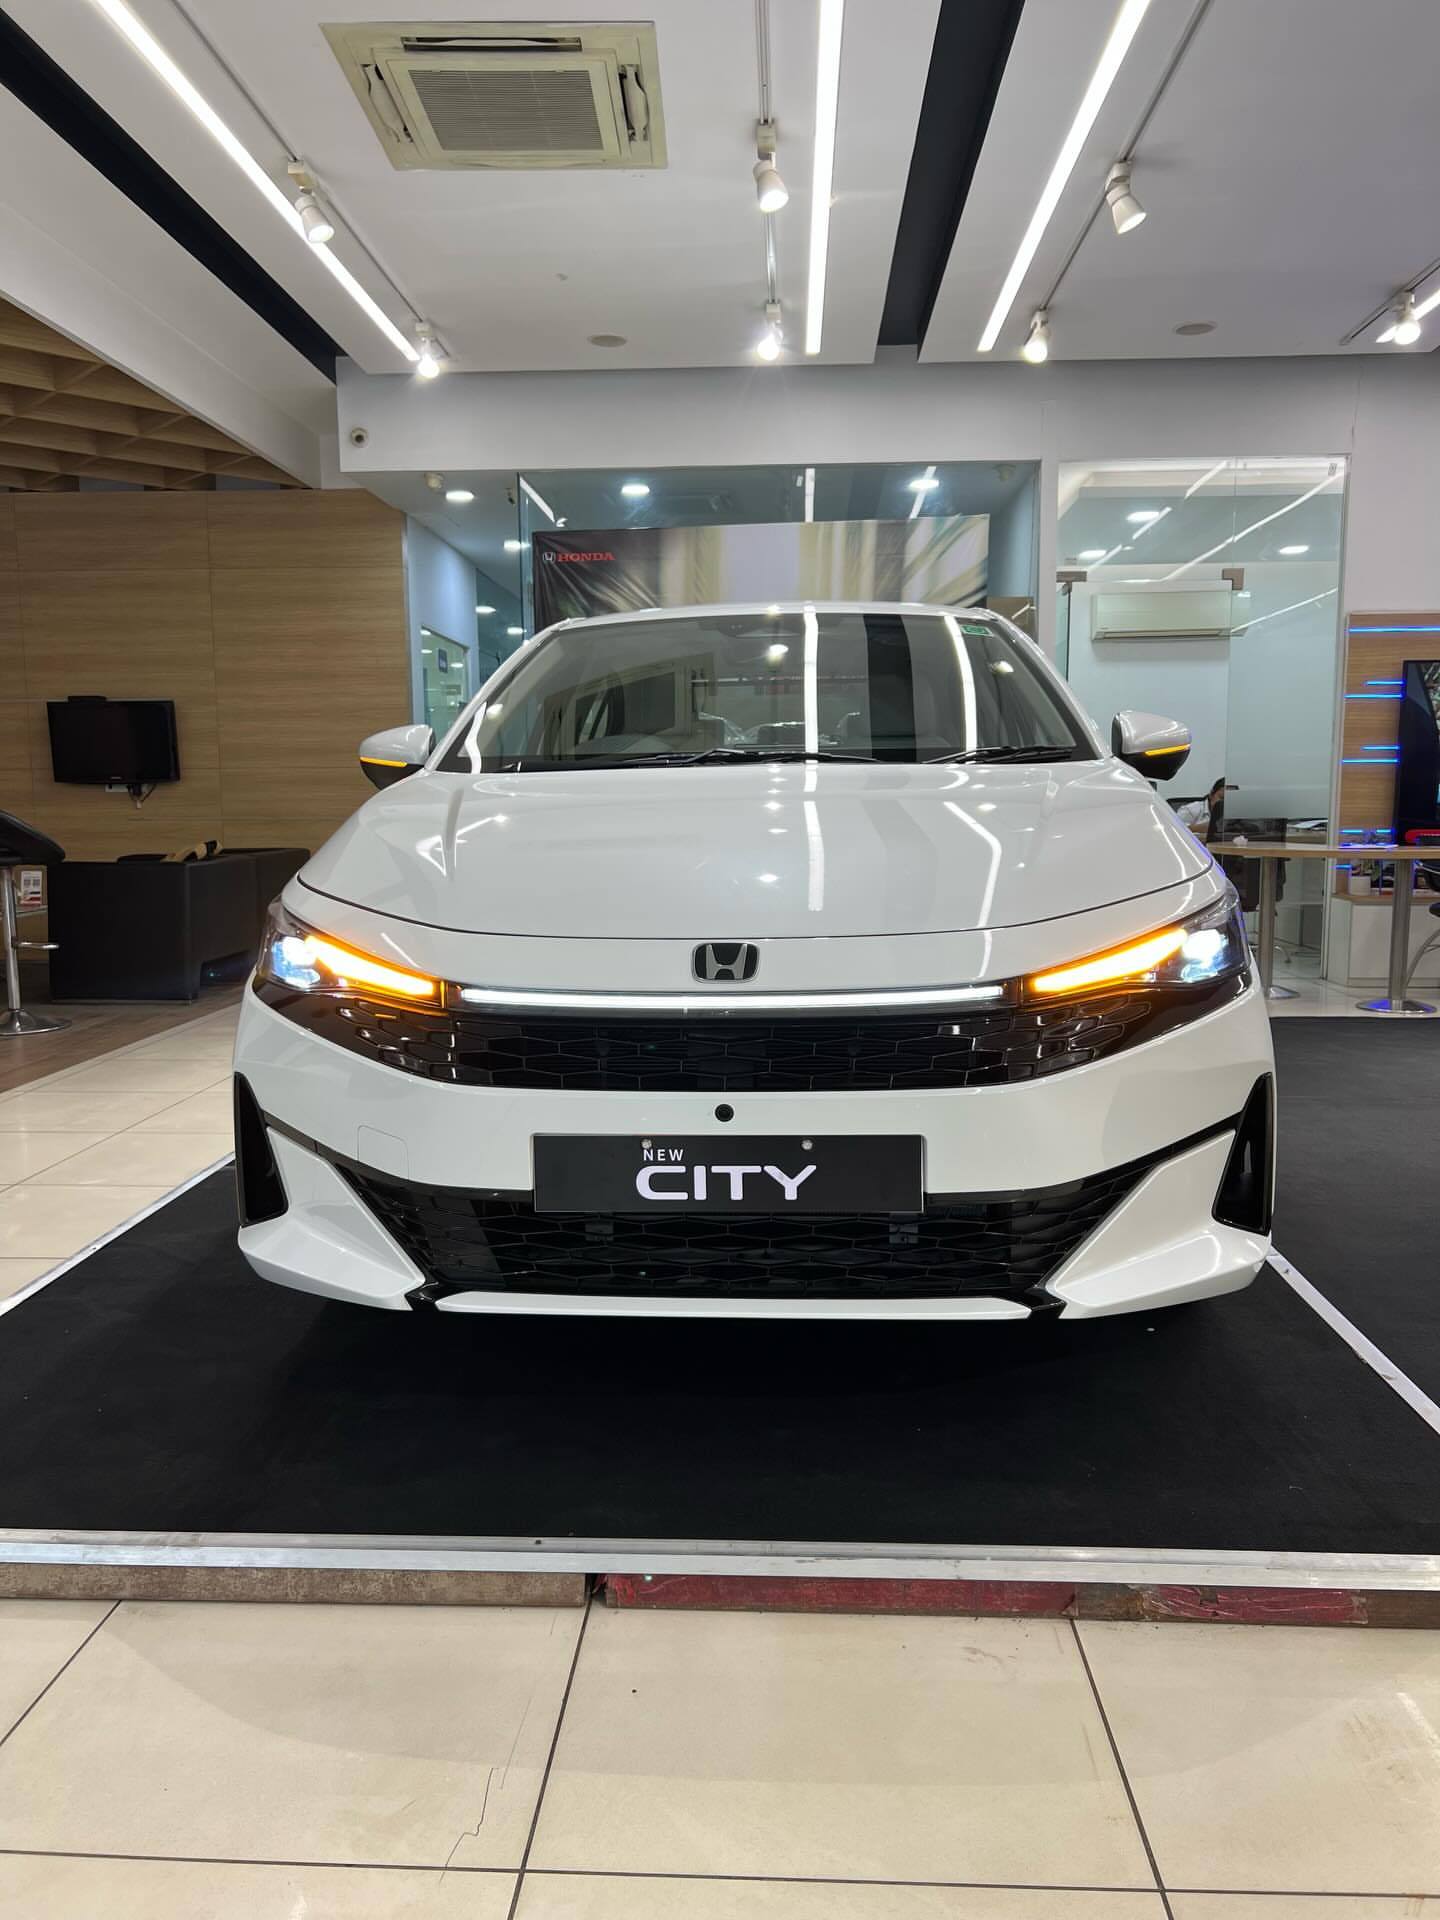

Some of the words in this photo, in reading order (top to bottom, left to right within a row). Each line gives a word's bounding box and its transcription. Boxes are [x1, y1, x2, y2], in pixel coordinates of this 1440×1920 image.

[557, 552, 616, 562] HONDA
[643, 1149, 684, 1161] NEW
[635, 1165, 817, 1200] CITY
